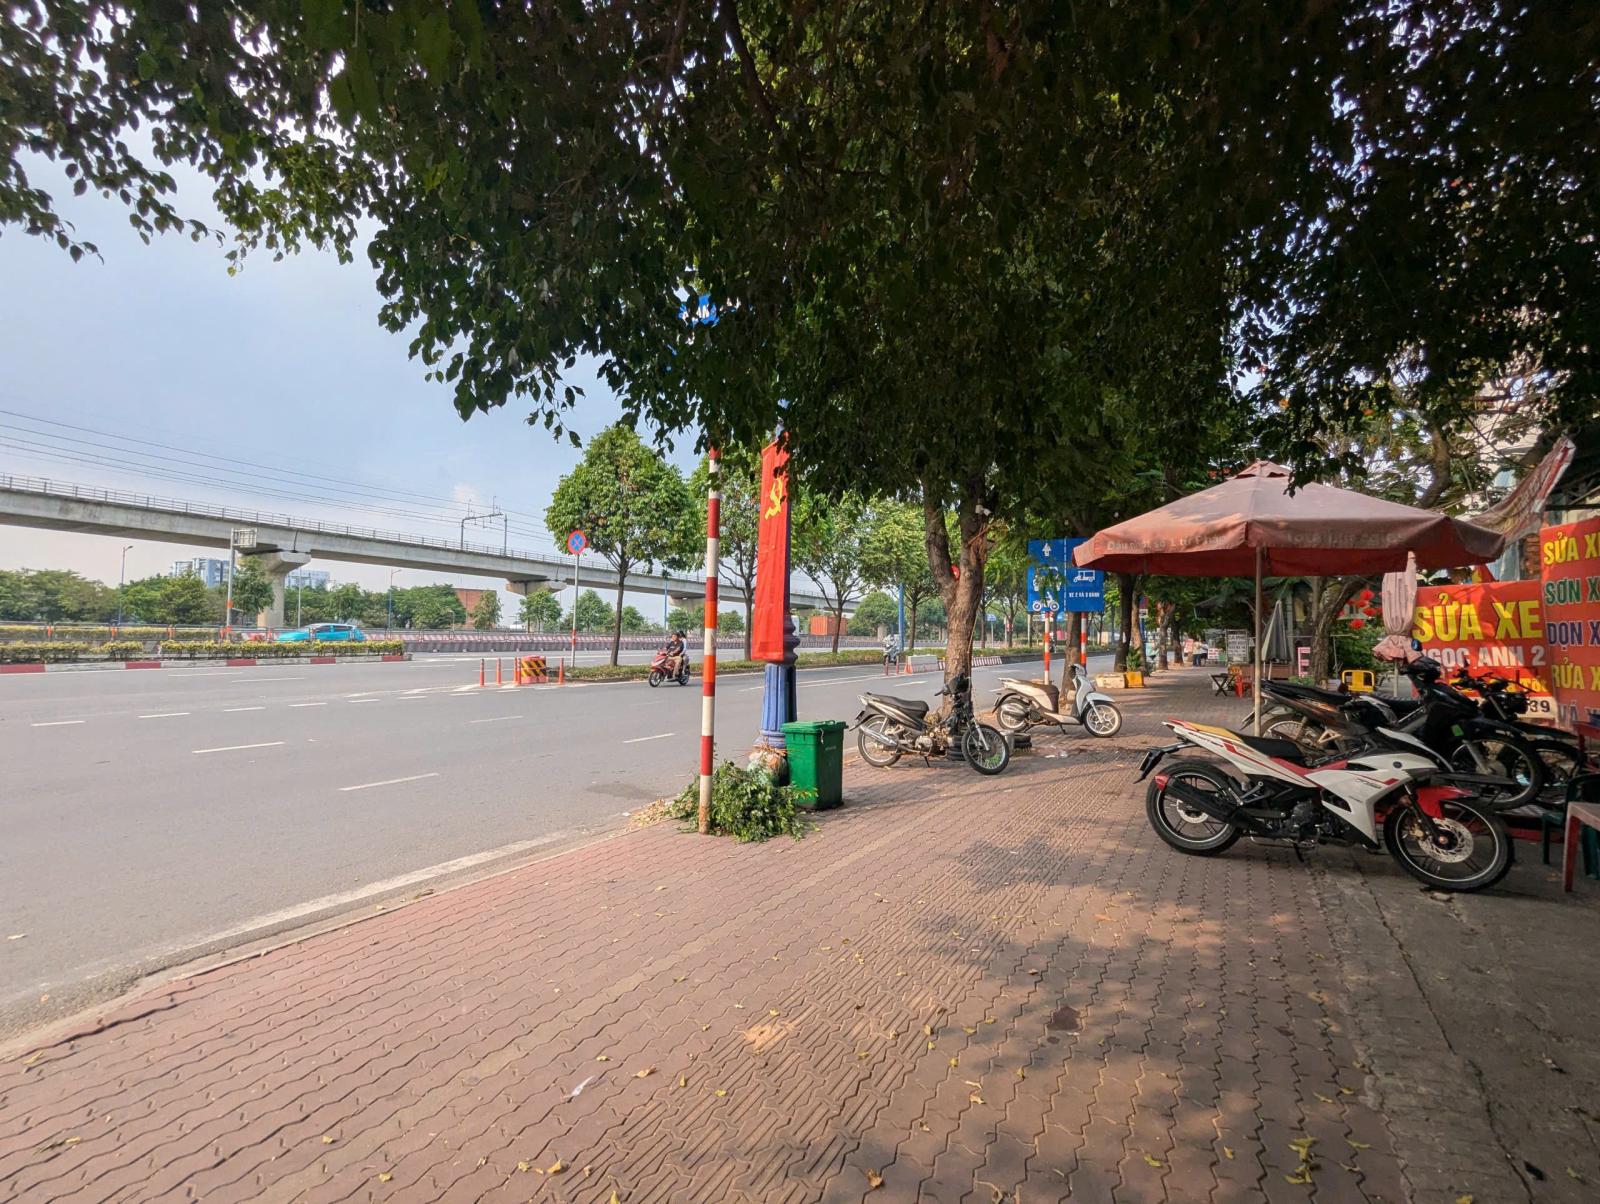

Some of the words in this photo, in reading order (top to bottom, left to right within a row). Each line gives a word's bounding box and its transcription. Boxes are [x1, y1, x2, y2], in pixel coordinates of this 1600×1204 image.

[1543, 532, 1579, 565] SỬA
[1545, 577, 1582, 605] SƠN
[1412, 593, 1483, 642] SỬA
[1493, 600, 1542, 639] XE
[1545, 620, 1584, 651] DỌN
[1478, 646, 1525, 667] ANH
[1530, 645, 1547, 666] 2
[1551, 657, 1584, 690] RỬA
